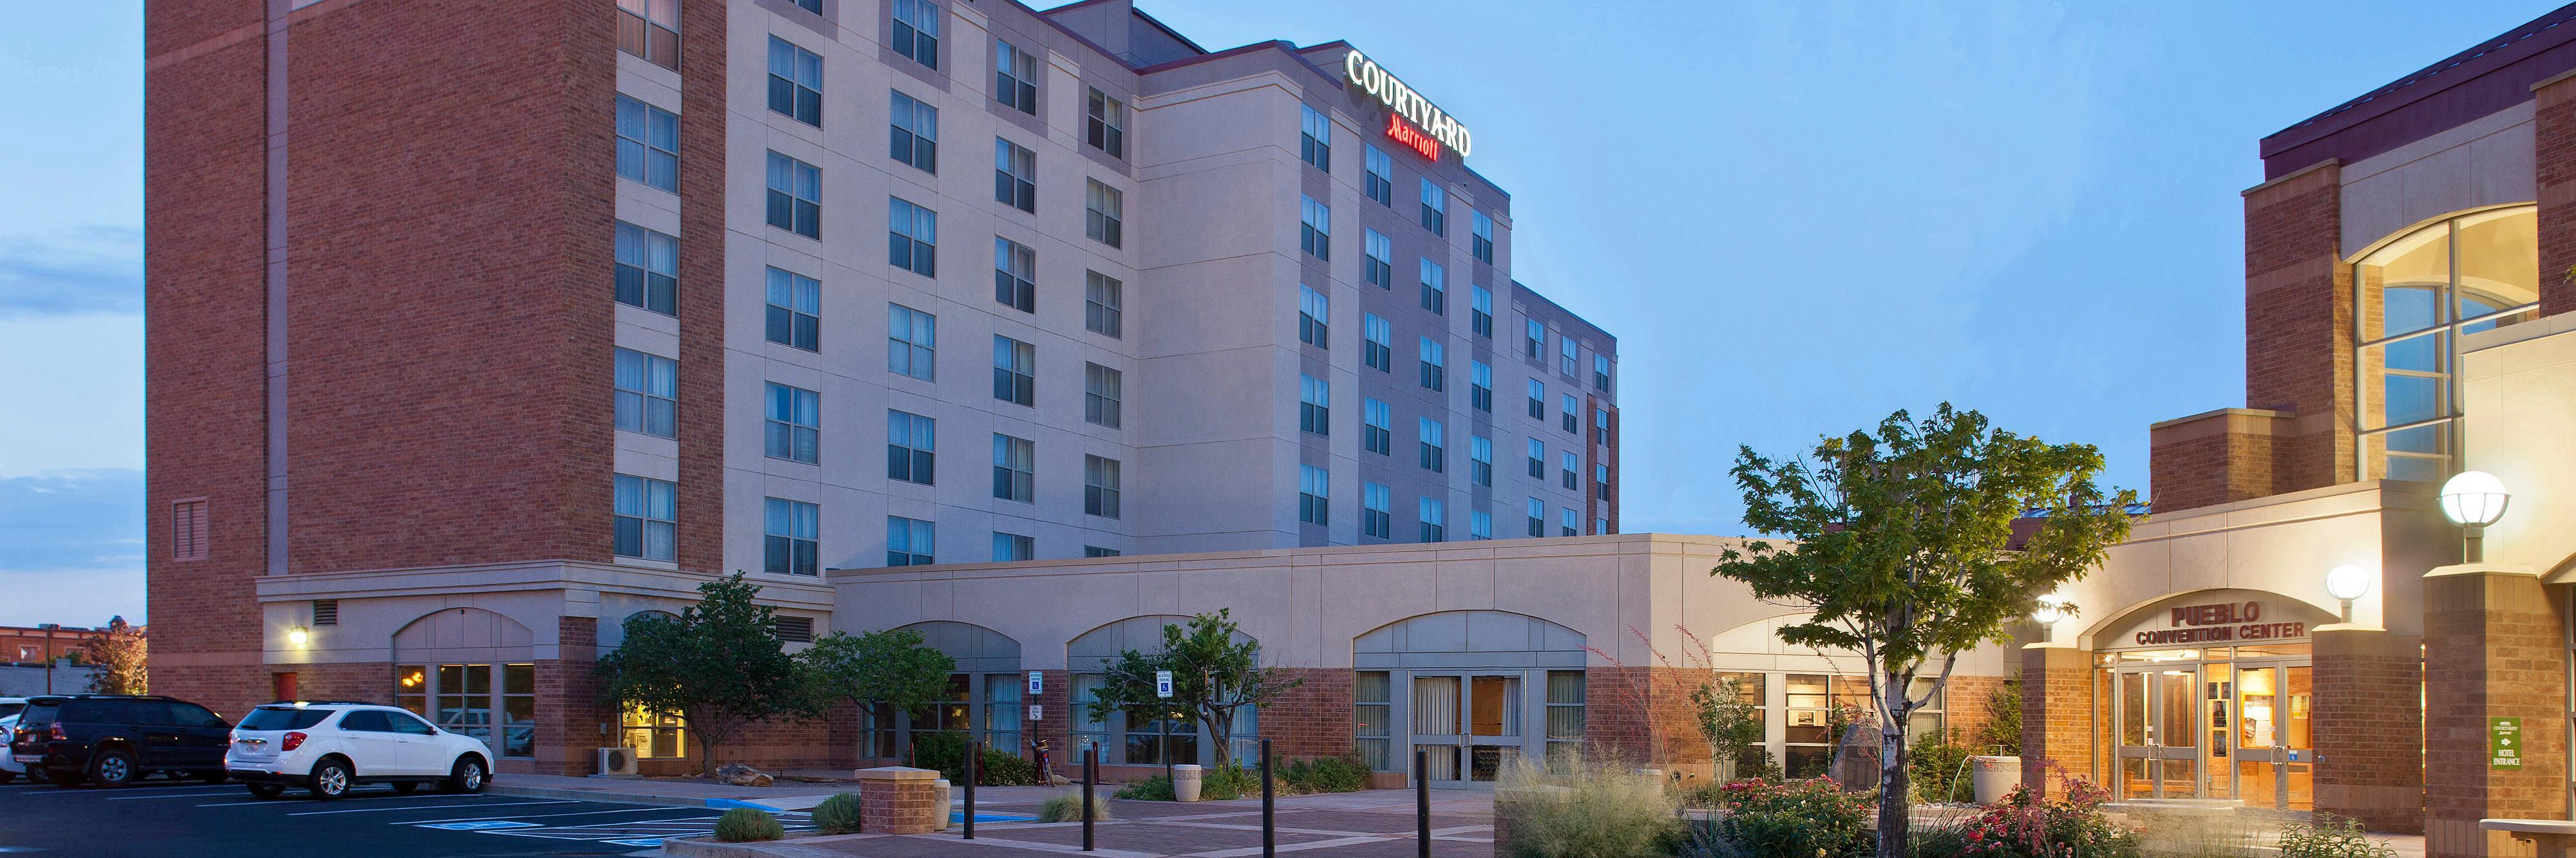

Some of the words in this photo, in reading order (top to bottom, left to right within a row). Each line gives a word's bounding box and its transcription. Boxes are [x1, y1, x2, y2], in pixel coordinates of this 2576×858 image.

[1347, 50, 1472, 157] COURTYARD
[1388, 113, 1439, 162] Marriott
[2172, 601, 2260, 627] PUEBLO
[2136, 626, 2232, 645] CONVENTION
[2239, 622, 2304, 639] CENTER
